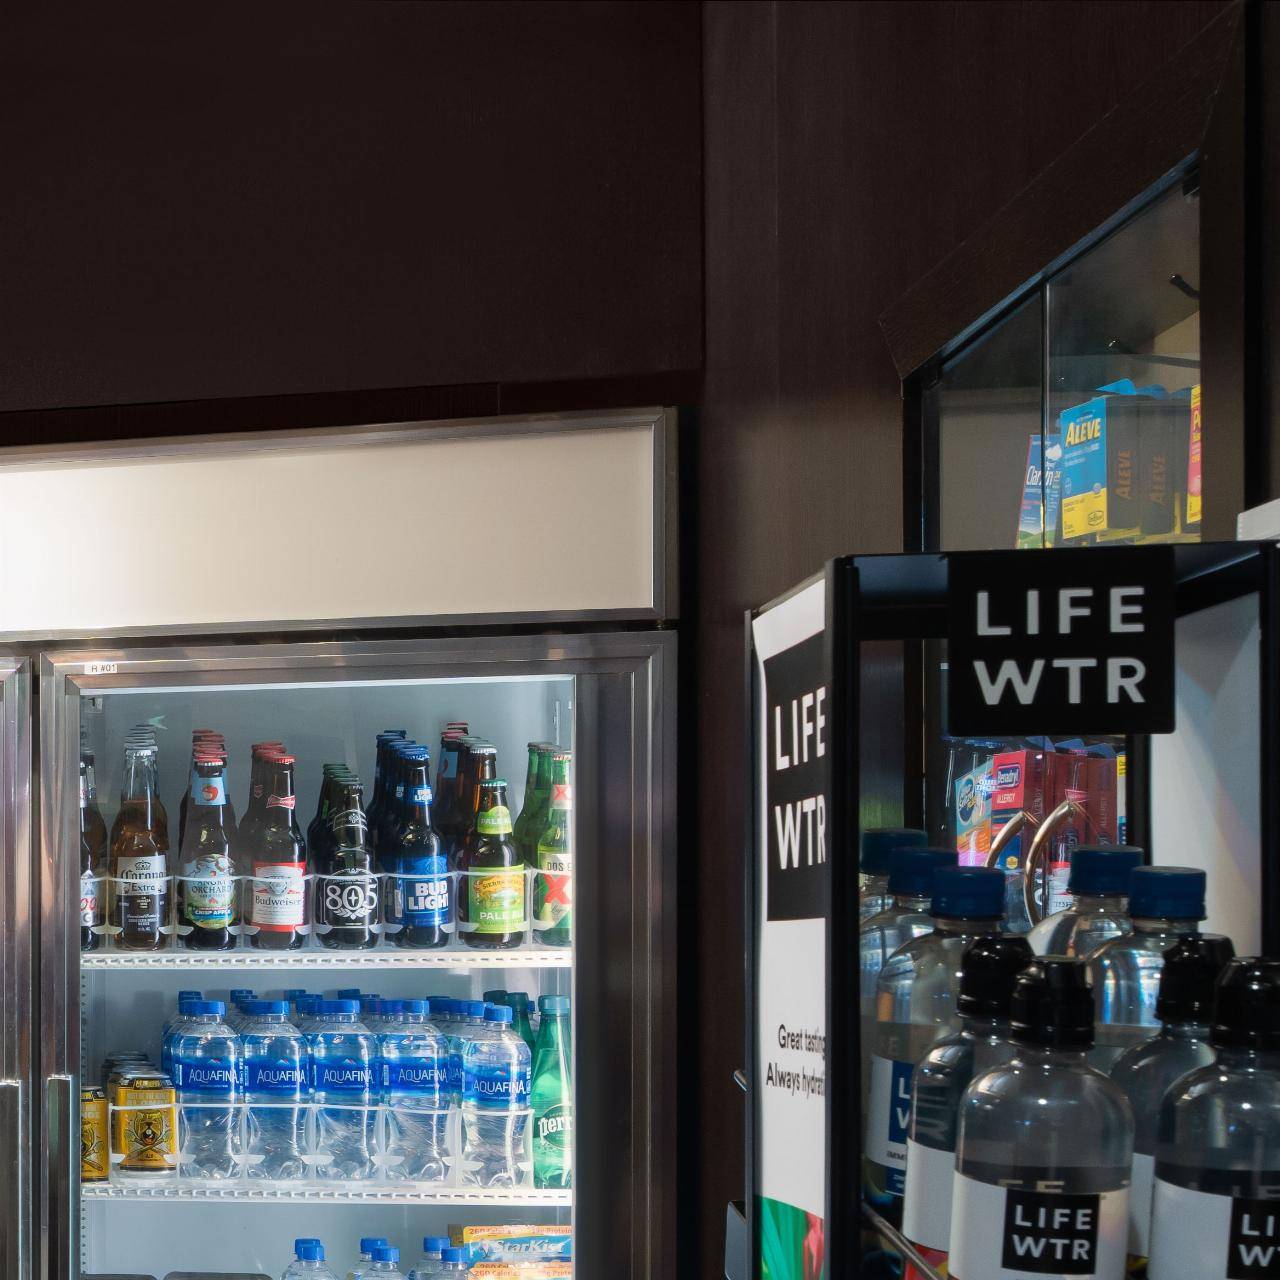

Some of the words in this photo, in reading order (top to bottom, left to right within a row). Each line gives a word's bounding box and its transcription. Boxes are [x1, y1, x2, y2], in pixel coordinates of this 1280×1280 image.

[974, 585, 1147, 637] LIFE
[972, 656, 1148, 707] WTR
[774, 686, 827, 772] LIFE
[774, 794, 827, 871] WTR
[546, 861, 564, 872] DOS
[131, 882, 156, 893] Extra
[190, 885, 232, 895] ORCHARD
[325, 881, 378, 911] 805
[415, 880, 448, 897] BUD
[255, 895, 302, 906] Budweiser
[777, 1023, 803, 1053] Great
[189, 1068, 241, 1084] AQUAFINA
[256, 1068, 307, 1084] AQUAFINA
[323, 1067, 374, 1084] AQUAFINA
[765, 1060, 802, 1093] Always
[473, 1079, 527, 1095] AQUAFINA
[1014, 1204, 1094, 1231] LIFE
[1012, 1233, 1092, 1262] WTR
